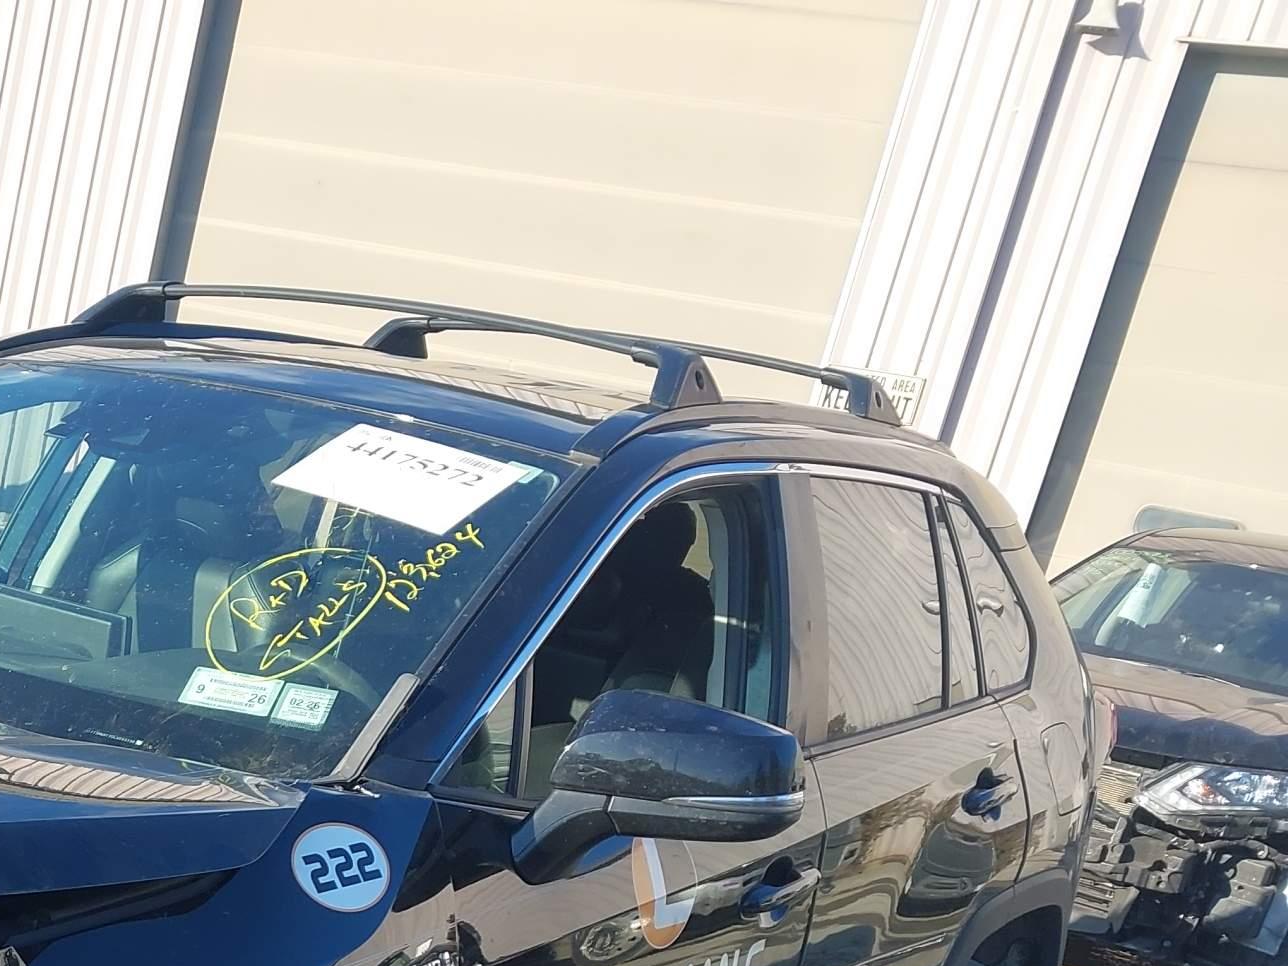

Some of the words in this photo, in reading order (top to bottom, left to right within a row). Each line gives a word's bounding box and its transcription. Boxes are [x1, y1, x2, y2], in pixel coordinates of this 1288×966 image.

[346, 441, 484, 487] 44175272
[195, 683, 206, 694] 9
[248, 692, 267, 705] 26
[302, 842, 383, 894] 222
